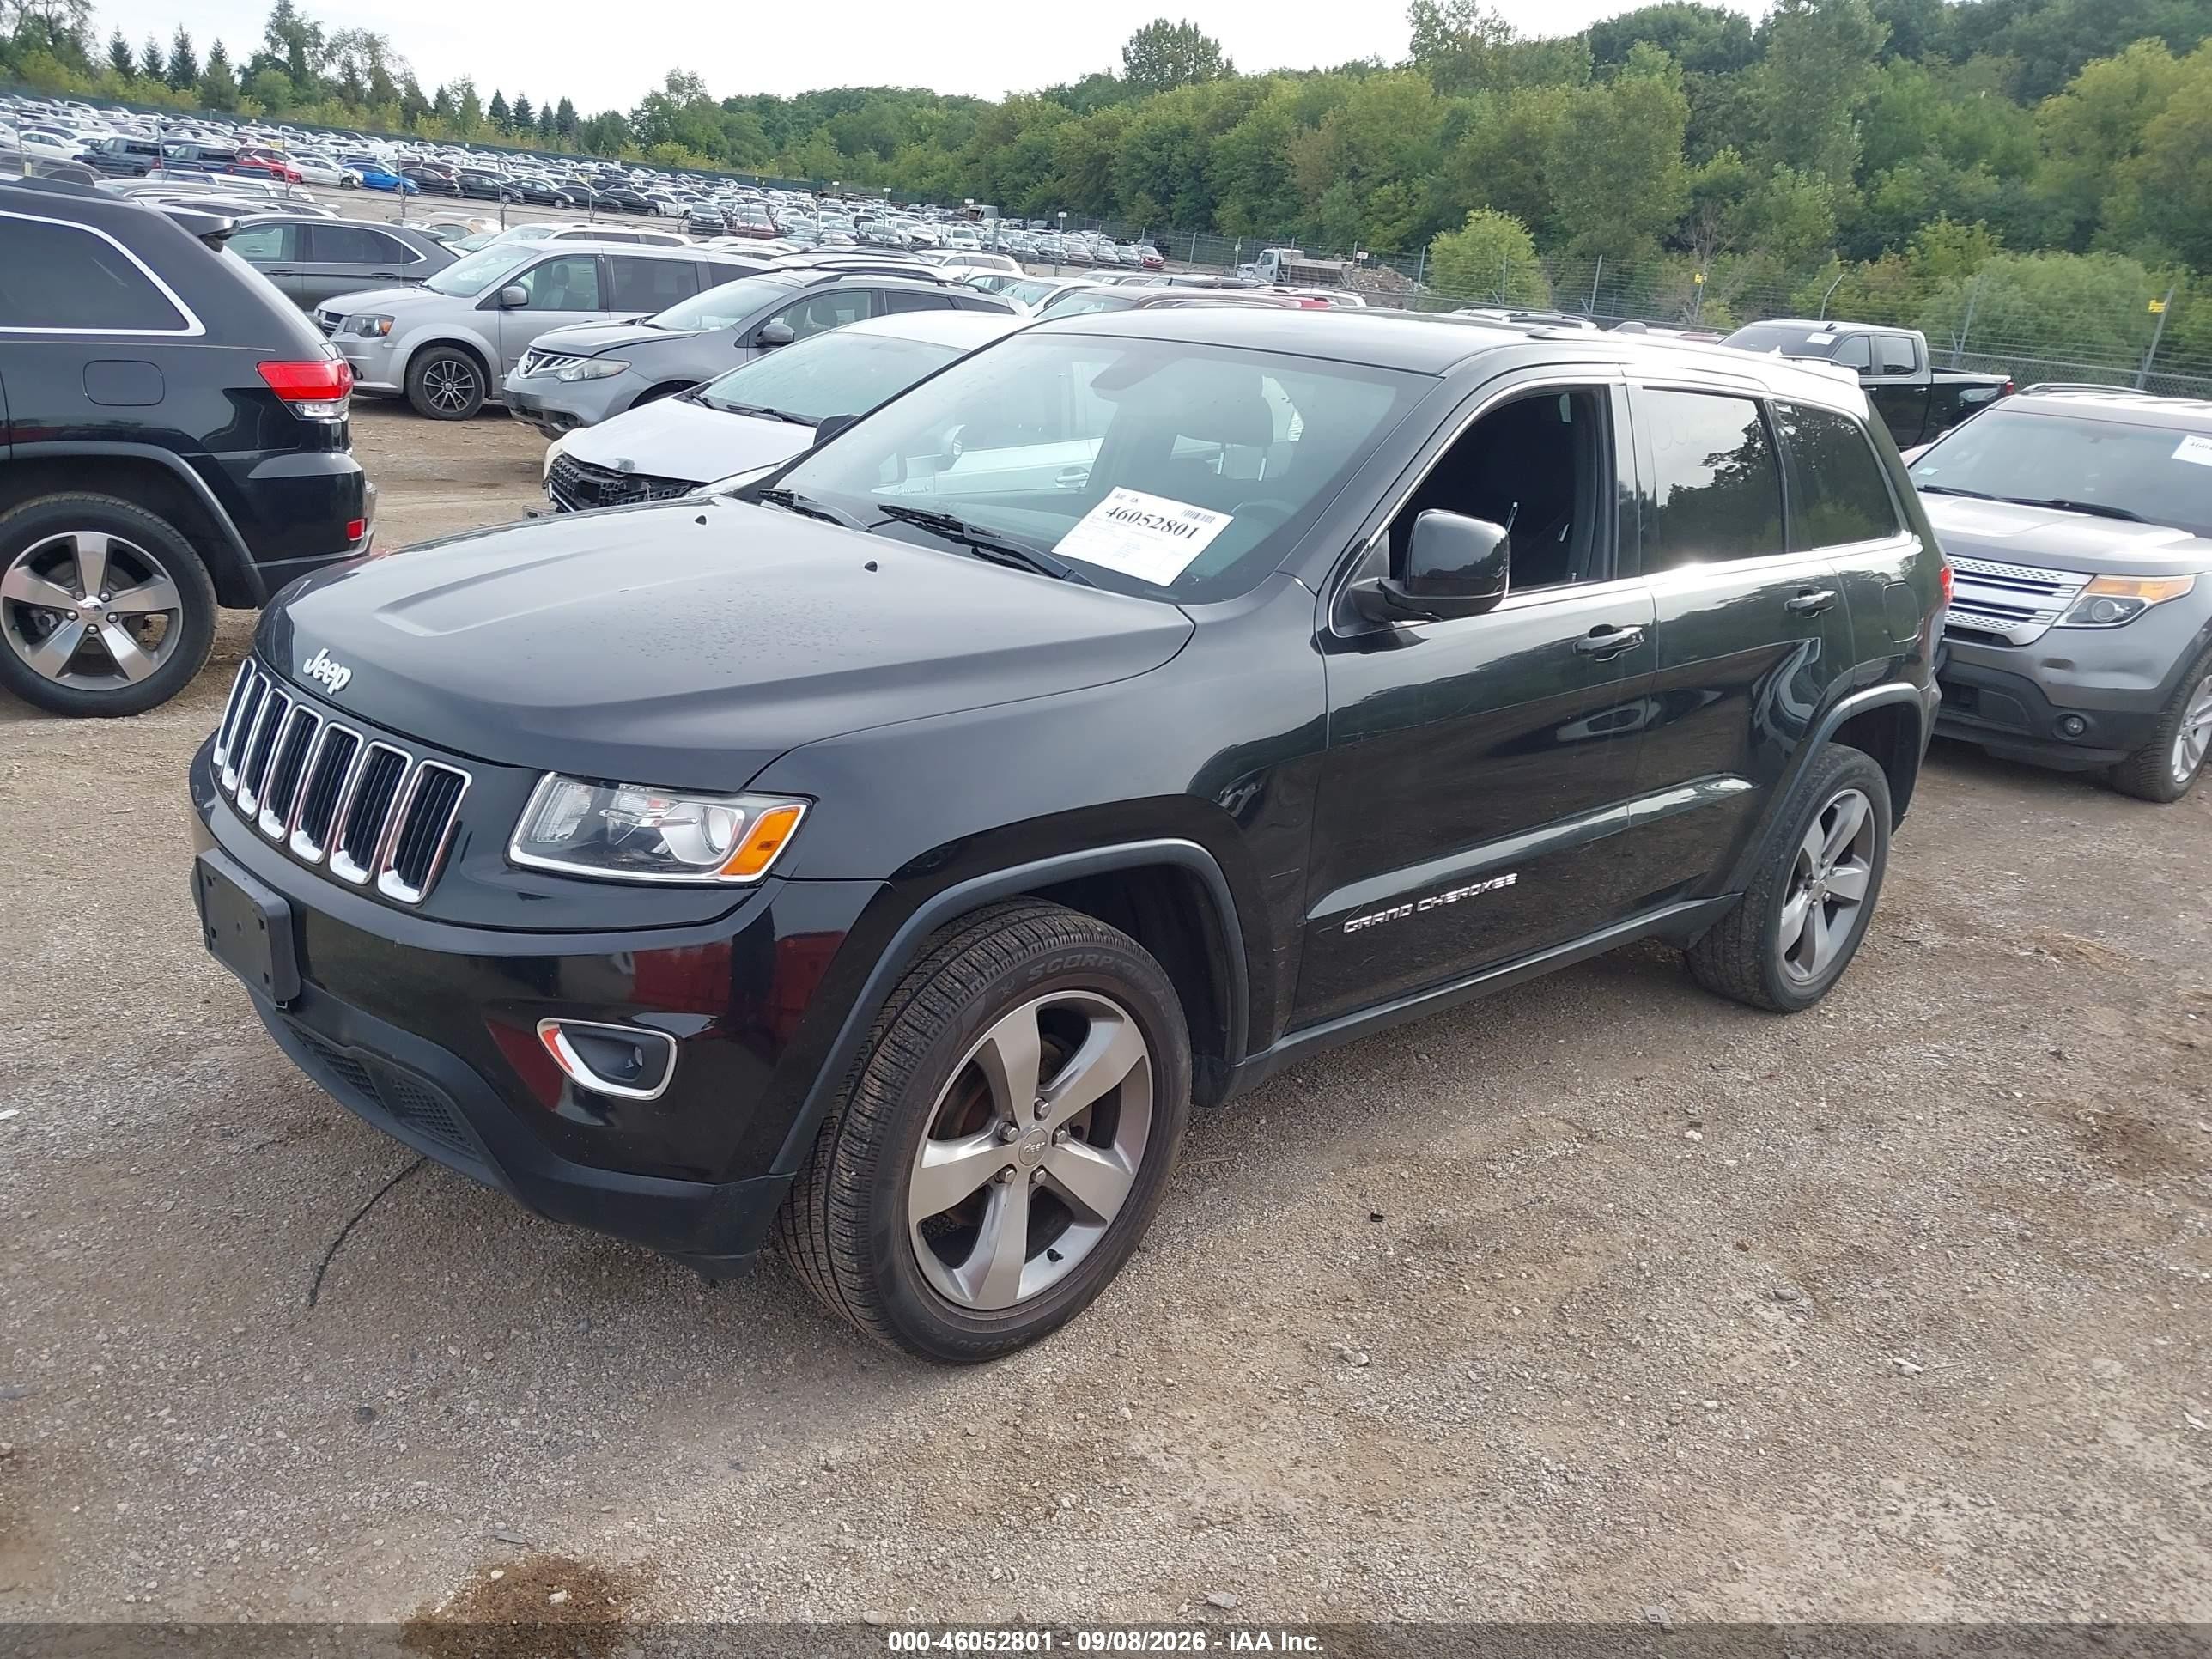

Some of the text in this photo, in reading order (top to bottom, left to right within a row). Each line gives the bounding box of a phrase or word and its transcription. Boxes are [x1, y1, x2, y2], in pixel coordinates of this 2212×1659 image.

[1105, 506, 1200, 539] 46052801
[303, 647, 352, 696] Jeep
[1343, 872, 1518, 933] GRAND CHEROKEE
